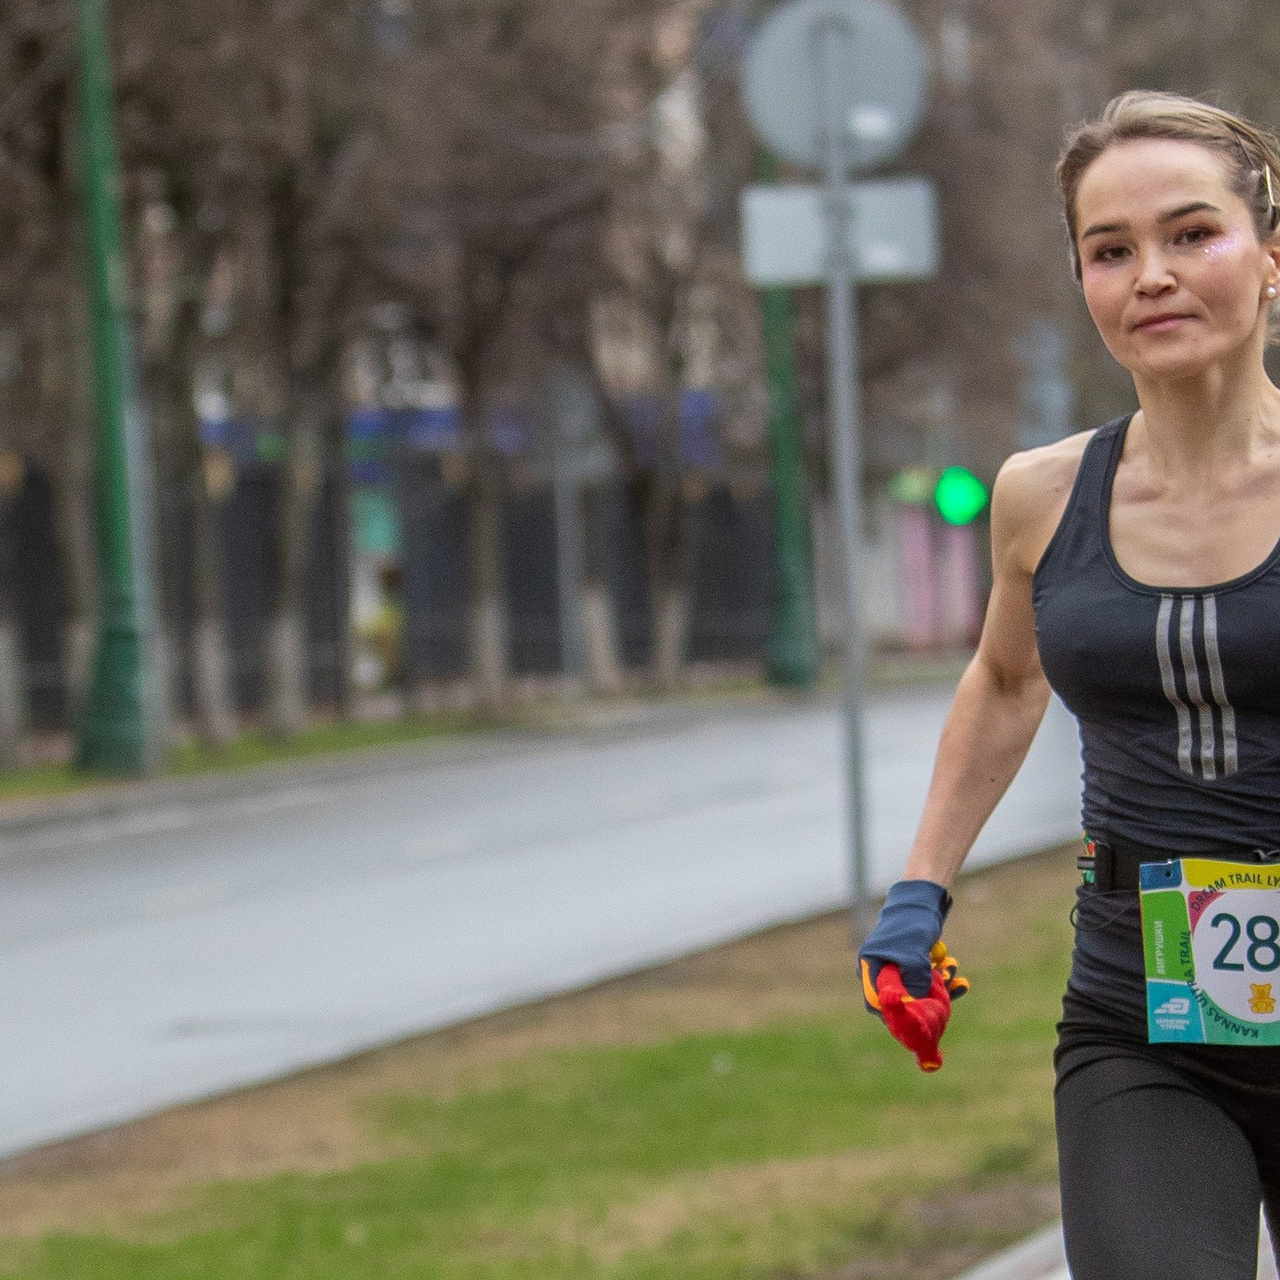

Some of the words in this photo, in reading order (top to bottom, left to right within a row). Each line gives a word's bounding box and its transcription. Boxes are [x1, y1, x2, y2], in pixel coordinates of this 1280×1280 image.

[1190, 877, 1227, 912] DREAM
[1228, 873, 1264, 886] TRAIL
[1180, 931, 1191, 966] TRAIL
[1184, 970, 1207, 1008] ULTRA
[1204, 1007, 1259, 1039] KANNAS
